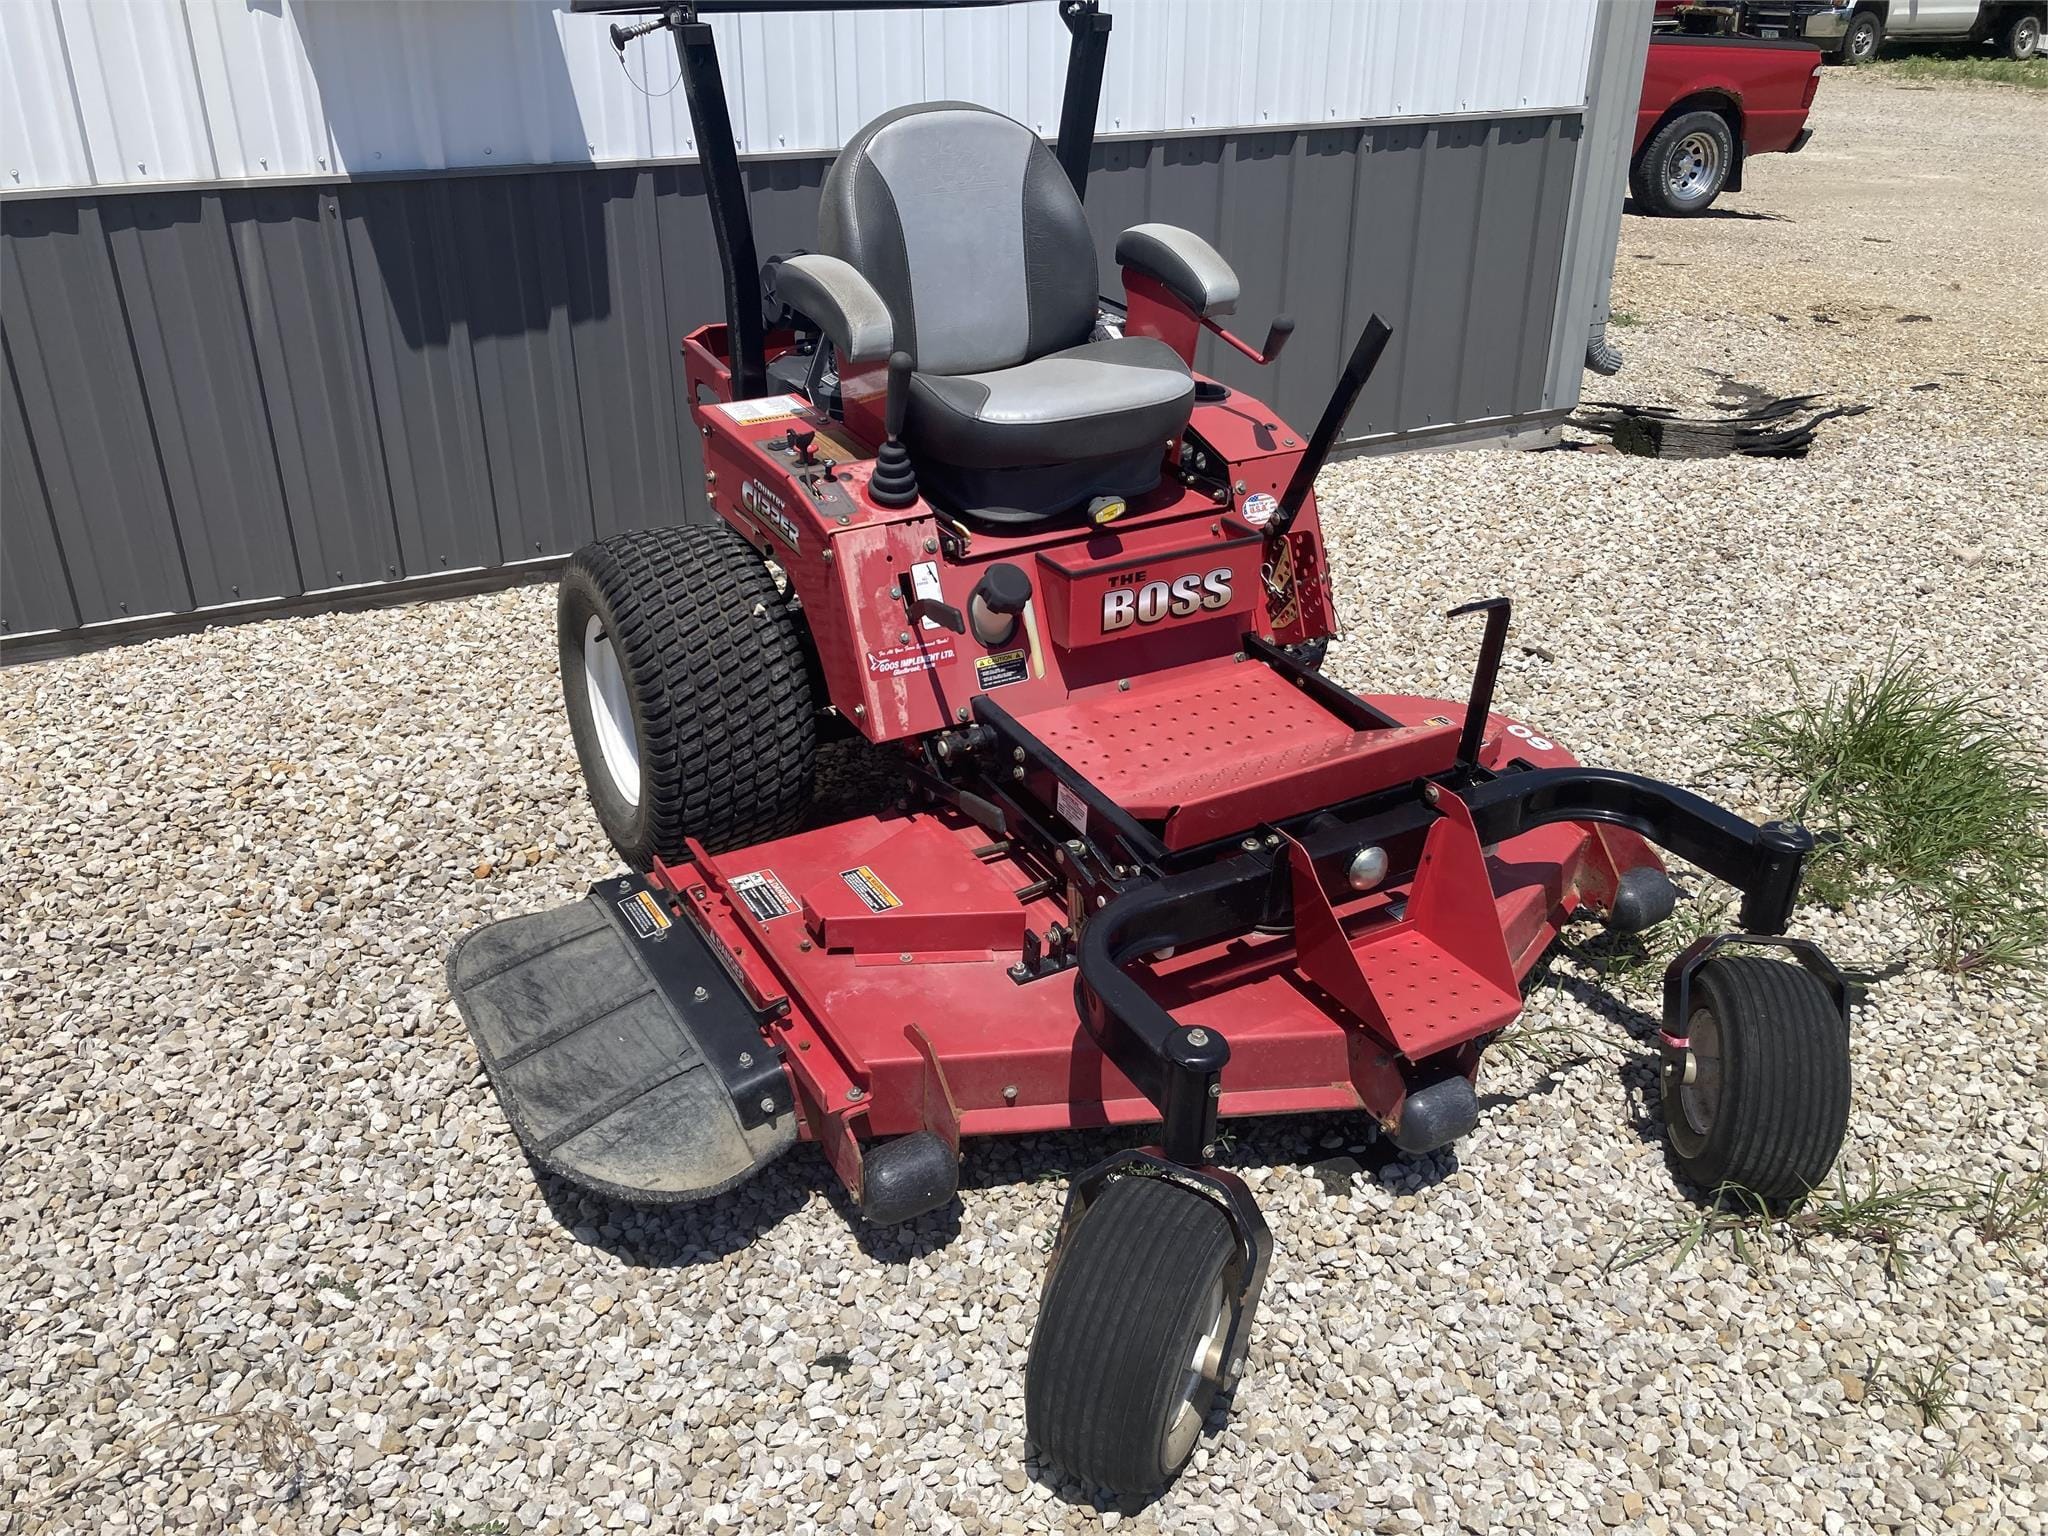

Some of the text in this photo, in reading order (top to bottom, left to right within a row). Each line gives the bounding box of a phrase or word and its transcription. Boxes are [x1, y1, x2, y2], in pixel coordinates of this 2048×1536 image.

[753, 478, 786, 509] COUNTRY
[742, 480, 800, 550] CLIPPER
[1108, 570, 1147, 587] THE
[1102, 567, 1233, 634] BOSS
[879, 649, 955, 672] GOOS IMPLEMENT LTD.
[987, 654, 1012, 665] CAUTION
[772, 881, 792, 904] DANGER
